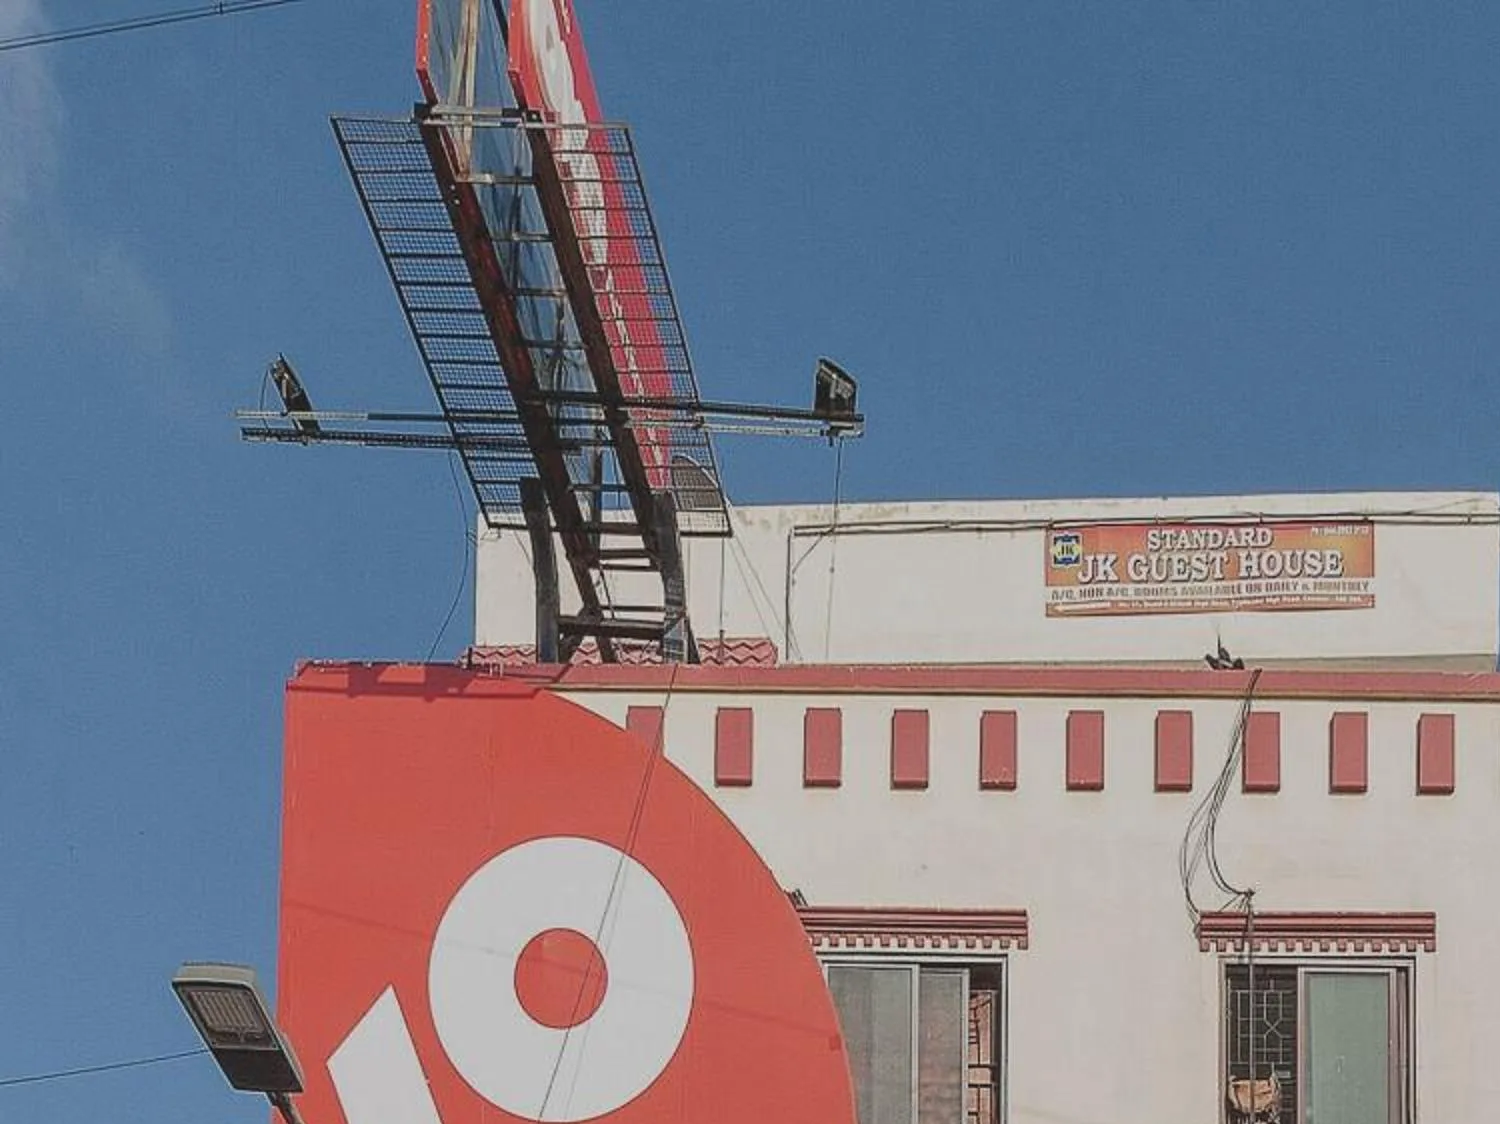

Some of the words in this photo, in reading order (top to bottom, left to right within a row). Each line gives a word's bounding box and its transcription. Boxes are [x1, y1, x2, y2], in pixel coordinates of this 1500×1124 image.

[1147, 527, 1275, 551] STANDARD
[1078, 555, 1120, 583] JK
[1127, 551, 1231, 582] GUEST
[1238, 549, 1345, 580] HOUSE
[1246, 582, 1263, 594] ON
[1265, 580, 1299, 593] DAILY
